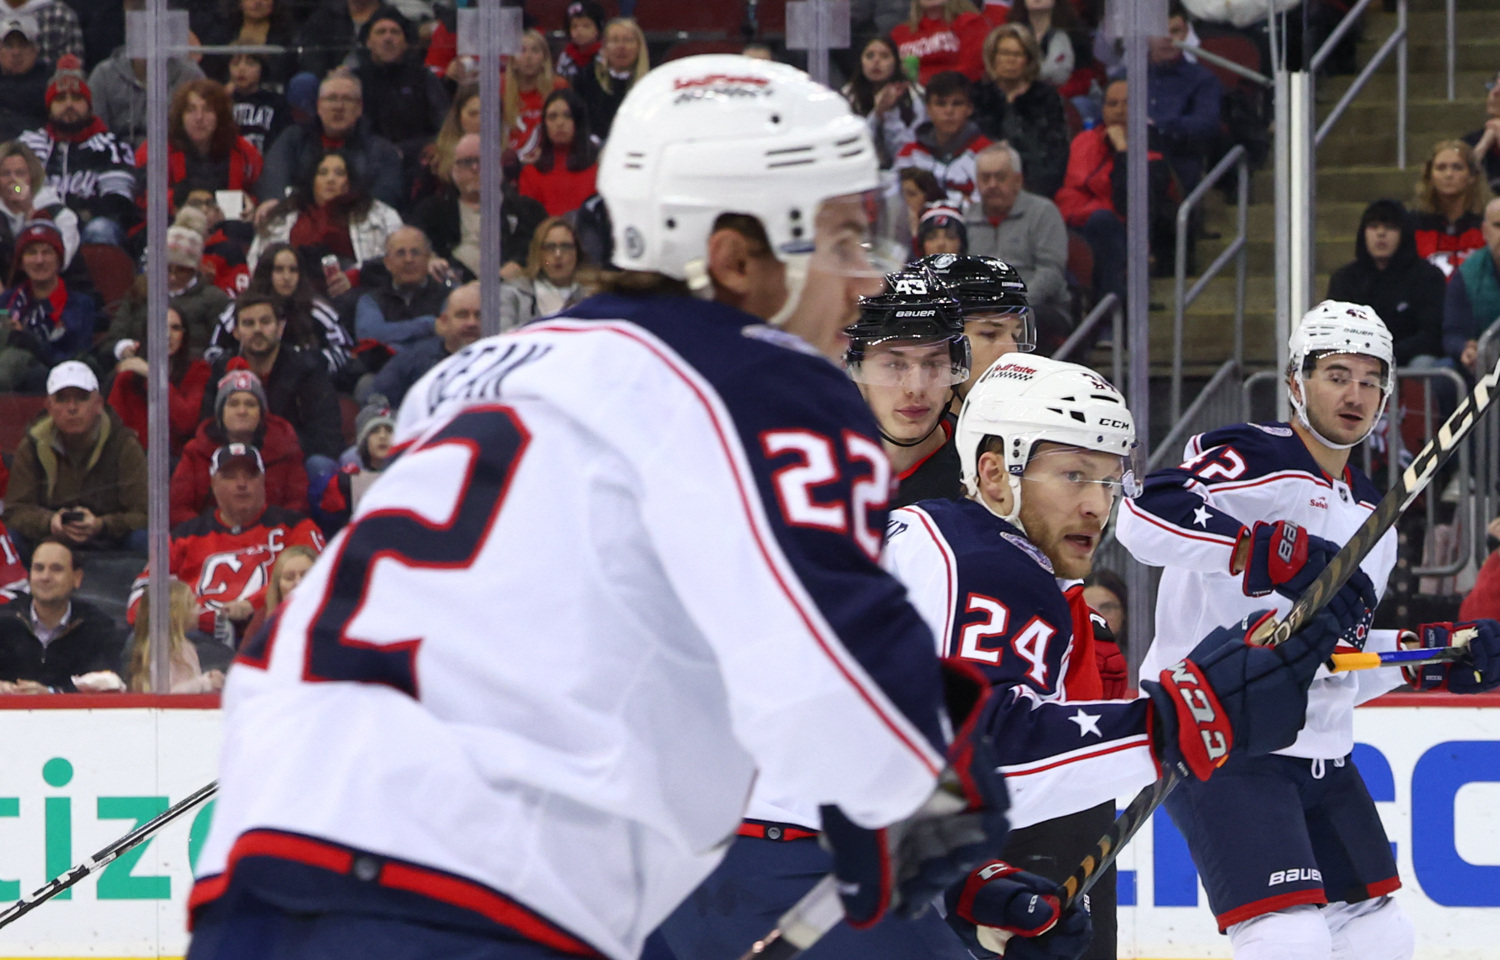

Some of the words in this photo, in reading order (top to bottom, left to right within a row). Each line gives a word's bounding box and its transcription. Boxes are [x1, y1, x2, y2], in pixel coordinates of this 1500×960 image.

[895, 279, 928, 295] 43
[1099, 417, 1130, 430] CCM
[757, 427, 893, 564] 22
[233, 403, 533, 703] 2
[957, 591, 1057, 690] 24
[1168, 658, 1228, 762] CCM
